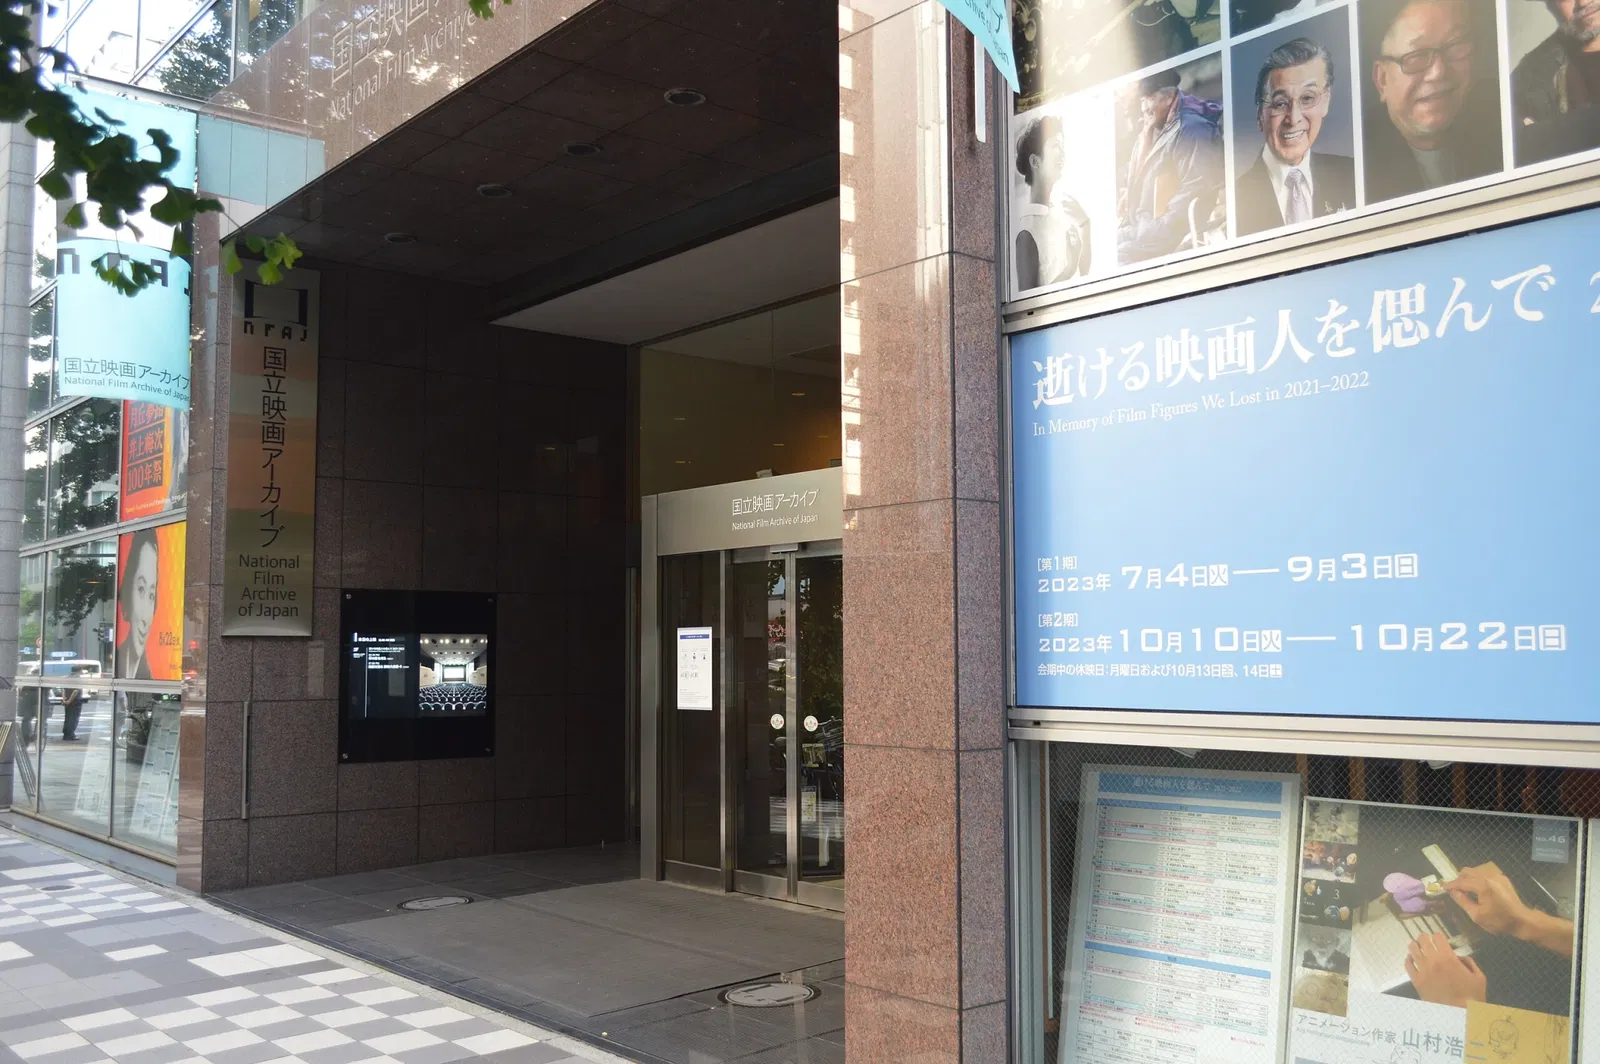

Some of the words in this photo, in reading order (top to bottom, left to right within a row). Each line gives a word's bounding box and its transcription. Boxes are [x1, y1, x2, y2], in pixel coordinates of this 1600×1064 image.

[1032, 264, 1556, 409] 逝ける映画人を偲んで
[64, 376, 105, 386] National
[108, 379, 129, 389] Film
[130, 381, 163, 395] Archive
[164, 387, 172, 396] of
[1033, 422, 1045, 436] In
[1048, 417, 1098, 434] Memory
[1101, 409, 1116, 425] of
[1117, 407, 1147, 423] Film
[1151, 400, 1198, 421] Figures
[1201, 394, 1225, 410] We
[1229, 391, 1261, 407] Lost
[1265, 389, 1279, 401] in
[260, 346, 288, 548] 国立映画アーカイブ
[732, 488, 820, 516] 国立映画アーカイブ
[732, 520, 756, 531] National
[756, 519, 769, 528] Film
[770, 516, 792, 527] Archive
[793, 514, 800, 524] of
[800, 514, 819, 524] Japan
[239, 554, 300, 569] National
[254, 571, 285, 585] Film
[1038, 573, 1111, 593] 2023年
[241, 587, 297, 601] Archive
[238, 603, 253, 617] of
[256, 603, 299, 620] Japan
[1039, 634, 1113, 653] 2023年
[1297, 1013, 1397, 1044] アニメーション作家
